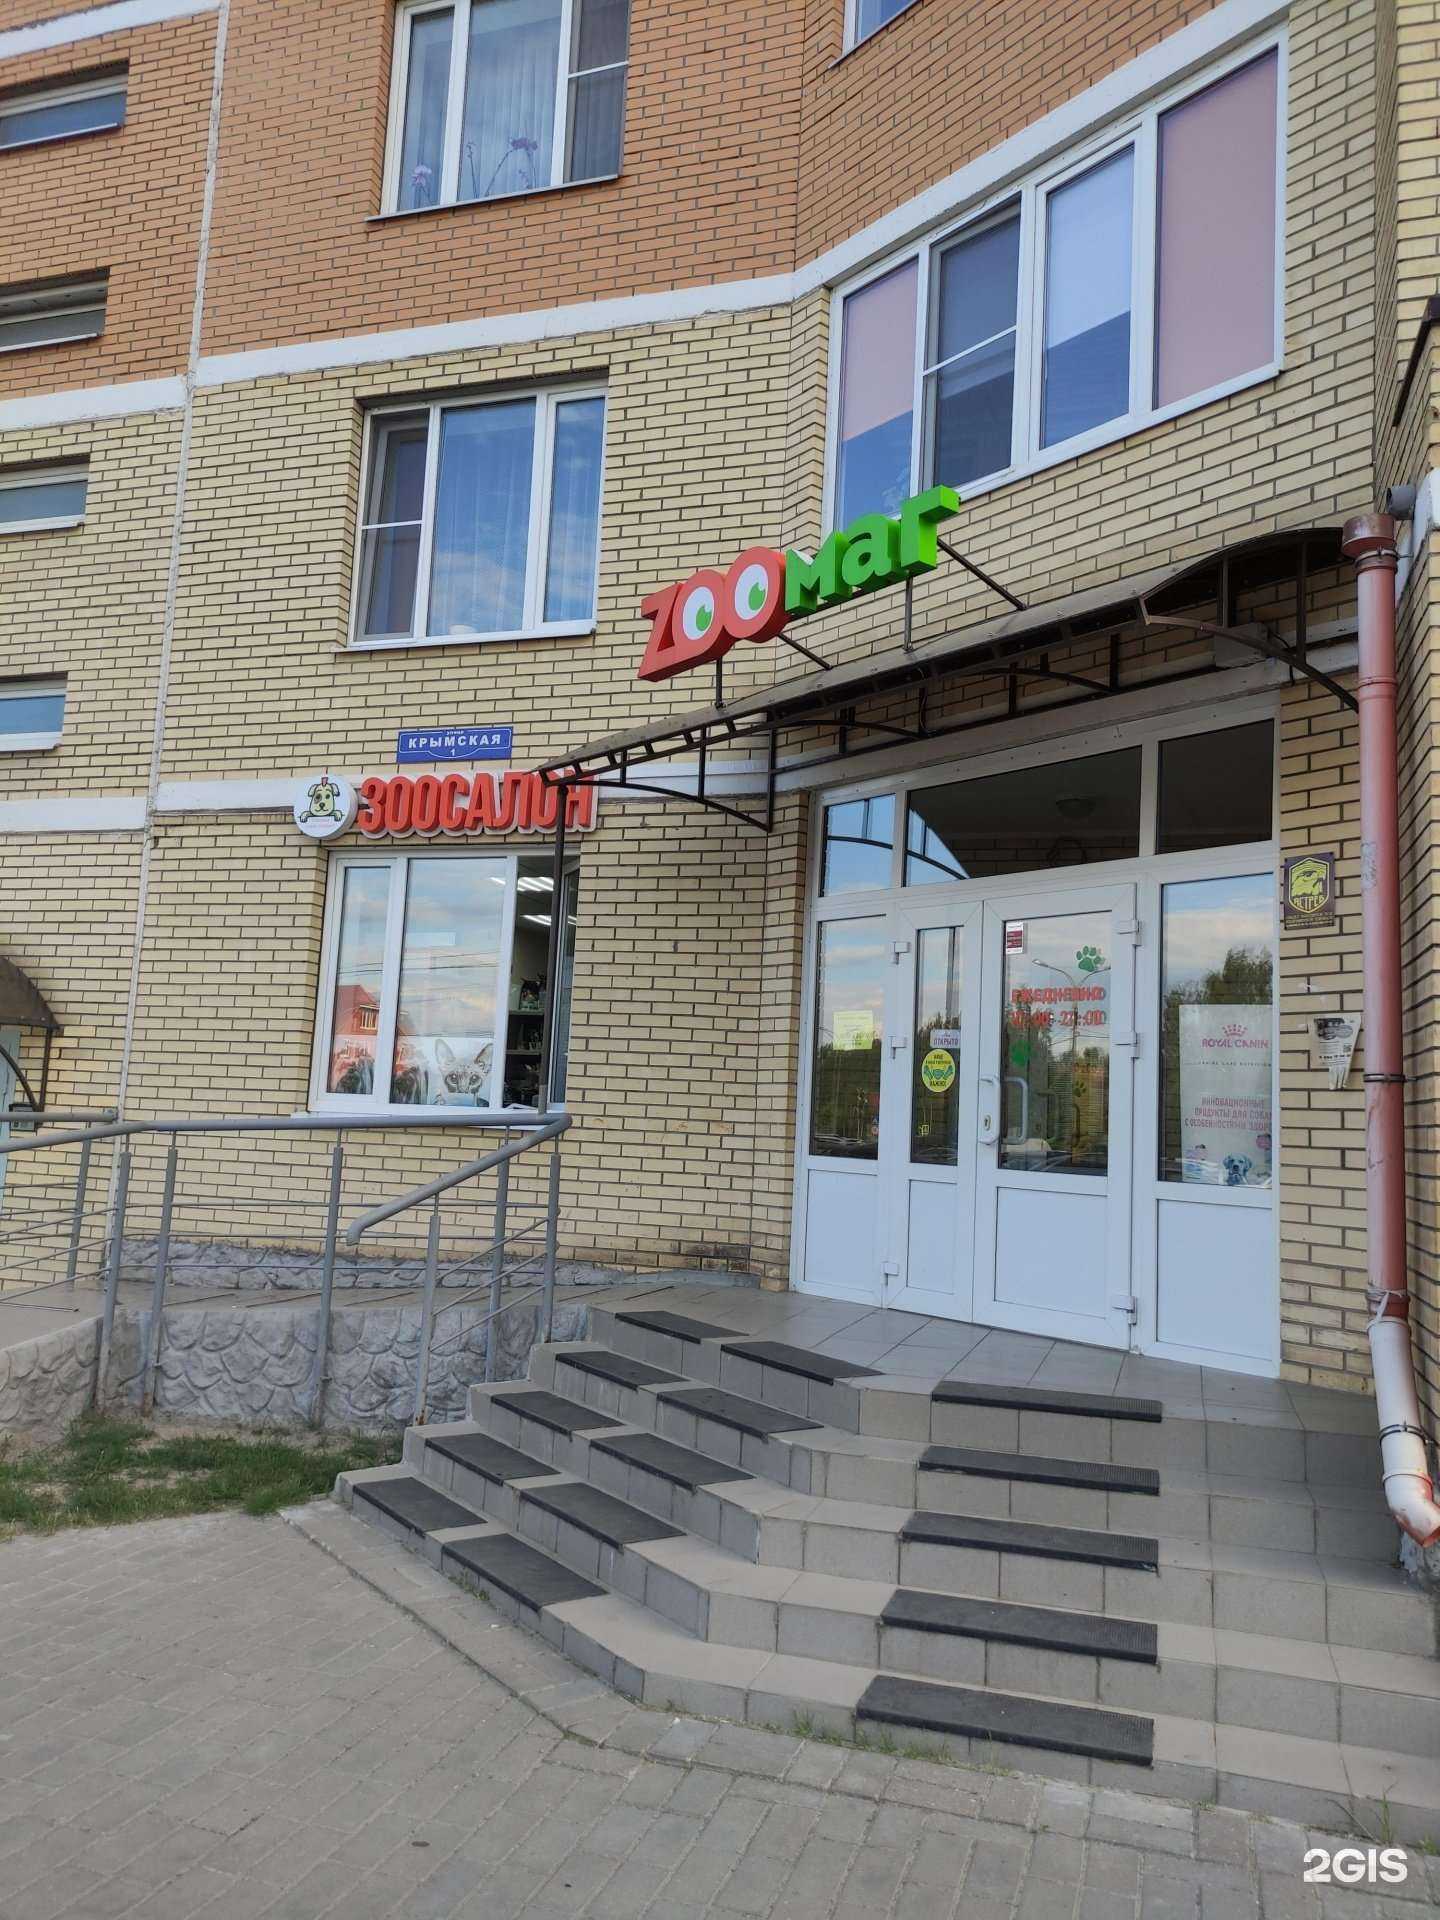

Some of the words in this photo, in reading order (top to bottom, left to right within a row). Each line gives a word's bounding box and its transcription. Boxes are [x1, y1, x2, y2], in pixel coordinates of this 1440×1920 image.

[408, 734, 501, 749] КРЫМСКАЯ
[450, 748, 456, 757] 1
[357, 770, 595, 834] ЗООСАЛОН
[1011, 986, 1105, 1004] ЕЖЕДНЕВНО
[1201, 1038, 1233, 1049] ROYAL
[1234, 1039, 1269, 1049] CANIN
